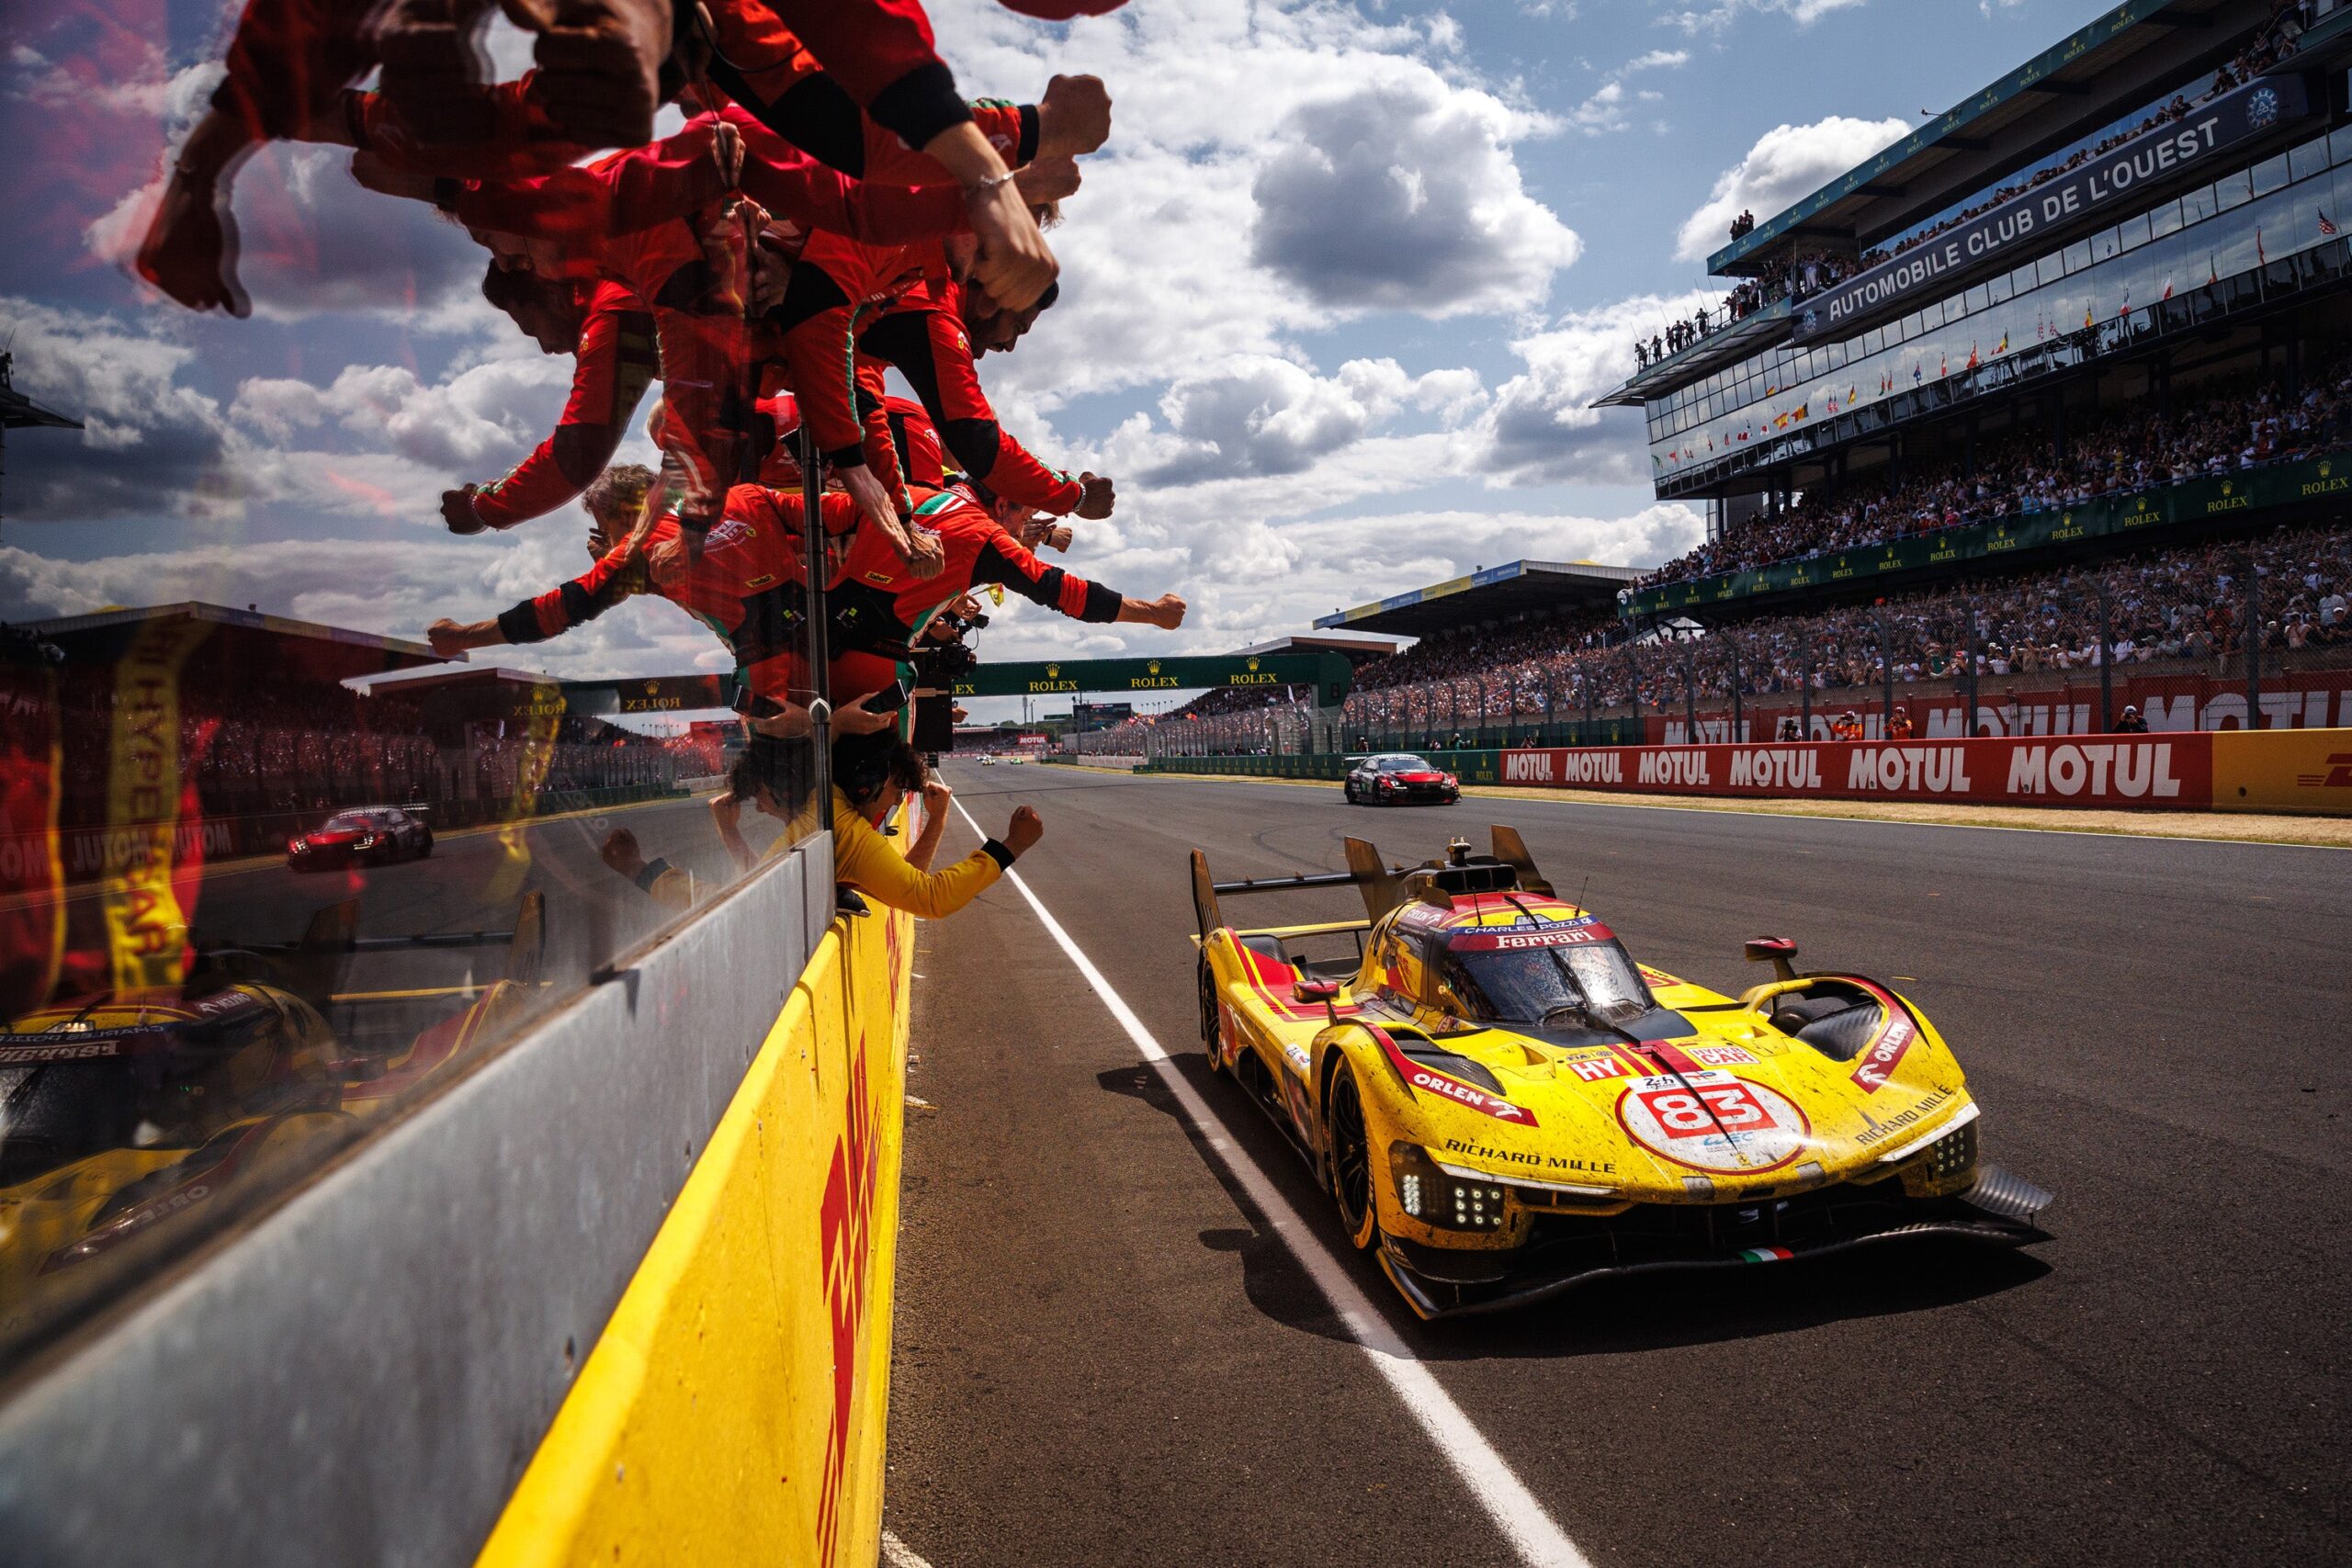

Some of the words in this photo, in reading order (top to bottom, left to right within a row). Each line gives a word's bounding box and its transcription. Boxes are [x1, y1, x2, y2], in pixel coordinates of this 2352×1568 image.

[2111, 14, 2135, 32] ROLEX
[2064, 43, 2086, 62] ROLEX
[2020, 70, 2041, 87] ROLEX
[1830, 242, 1962, 321] AUTOMOBILE
[1967, 208, 2034, 256] CLUB
[2042, 185, 2080, 222] DE
[2088, 117, 2219, 201] L'OUEST
[2301, 477, 2349, 495] ROLEX
[2207, 495, 2248, 513] ROLEX
[2124, 511, 2160, 526] ROLEX
[2052, 525, 2084, 540] ROLEX
[1987, 538, 2016, 551] ROLEX
[1879, 558, 1902, 570] ROLEX
[1930, 549, 1956, 561] ROLEX
[1791, 575, 1810, 586] ROLEX
[1832, 568, 1853, 579] ROLEX
[1029, 681, 1078, 692] ROLEX
[1131, 676, 1180, 688] ROLEX
[1230, 673, 1278, 684] ROLEX
[1019, 737, 1046, 745] MOTUL
[1476, 771, 1494, 781] ROLEX
[1506, 753, 1554, 781] MOTUL
[1565, 752, 1623, 783] MOTUL
[1637, 750, 1710, 785] MOTUL
[1729, 750, 1822, 788] MOTUL
[1848, 747, 1971, 792] MOTUL
[2007, 743, 2181, 797] MOTUL
[1464, 924, 1537, 934] CHARLES
[1540, 920, 1577, 930] POZZI
[1496, 929, 1596, 949] Ferrari
[1874, 1021, 1911, 1062] ORLEN
[1692, 1046, 1742, 1057] HYPER
[1703, 1053, 1756, 1065] CAR
[1571, 1057, 1623, 1082] HY
[1413, 1073, 1485, 1106] ORLEN
[1651, 1088, 1763, 1131] 83
[1855, 1110, 1919, 1145] RICHARD
[1915, 1085, 1953, 1114] MILLE
[1445, 1138, 1541, 1167] RICHARD
[1548, 1156, 1618, 1175] MILLE
